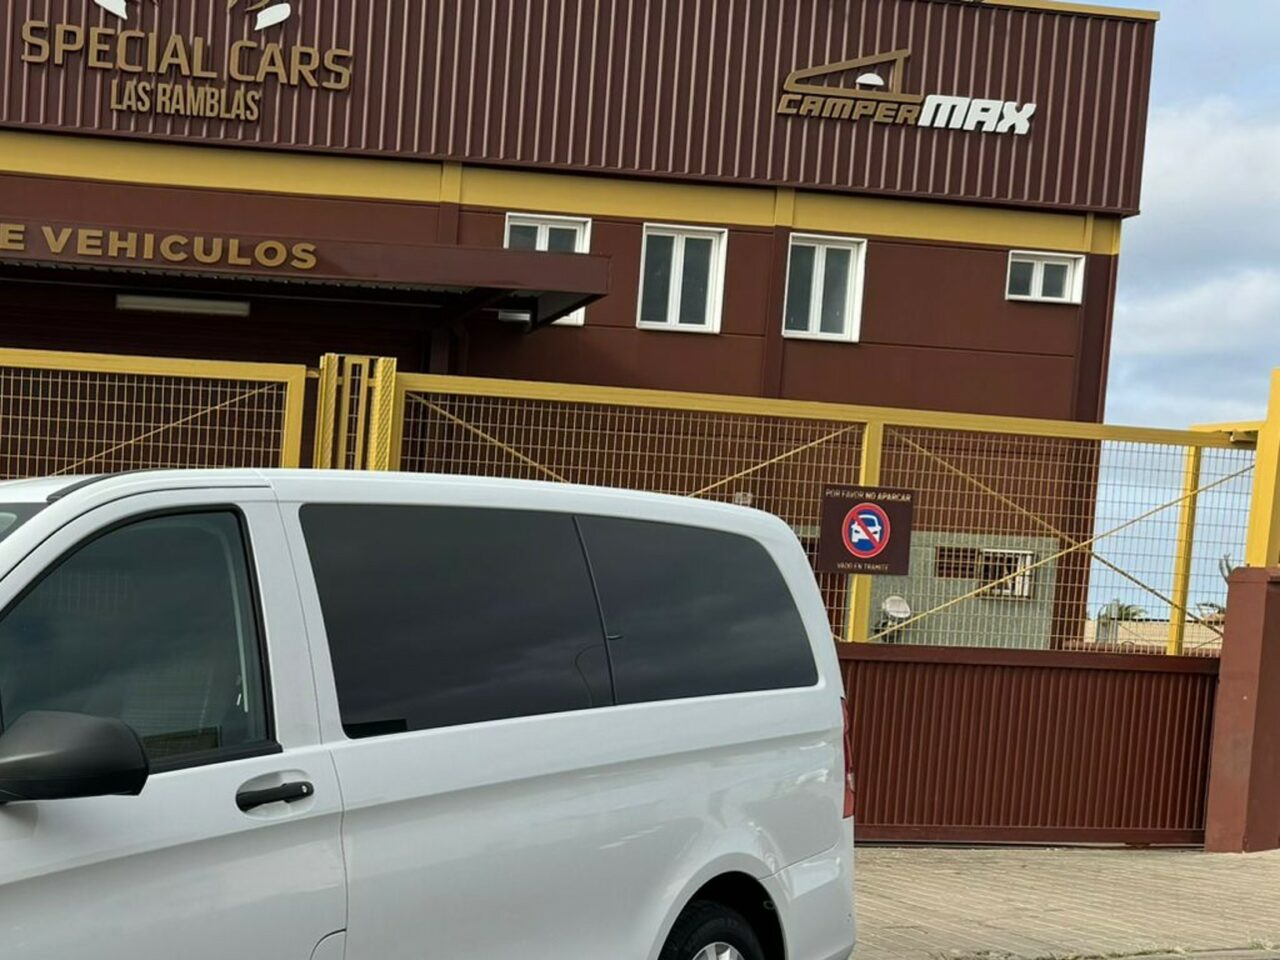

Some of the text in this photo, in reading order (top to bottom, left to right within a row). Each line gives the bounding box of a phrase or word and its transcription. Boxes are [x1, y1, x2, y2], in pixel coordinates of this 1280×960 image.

[21, 20, 353, 91] SPECIAL CARS
[110, 78, 262, 121] LAS RAMBLAS
[41, 226, 318, 270] VEHICULOS
[865, 491, 876, 500] NO
